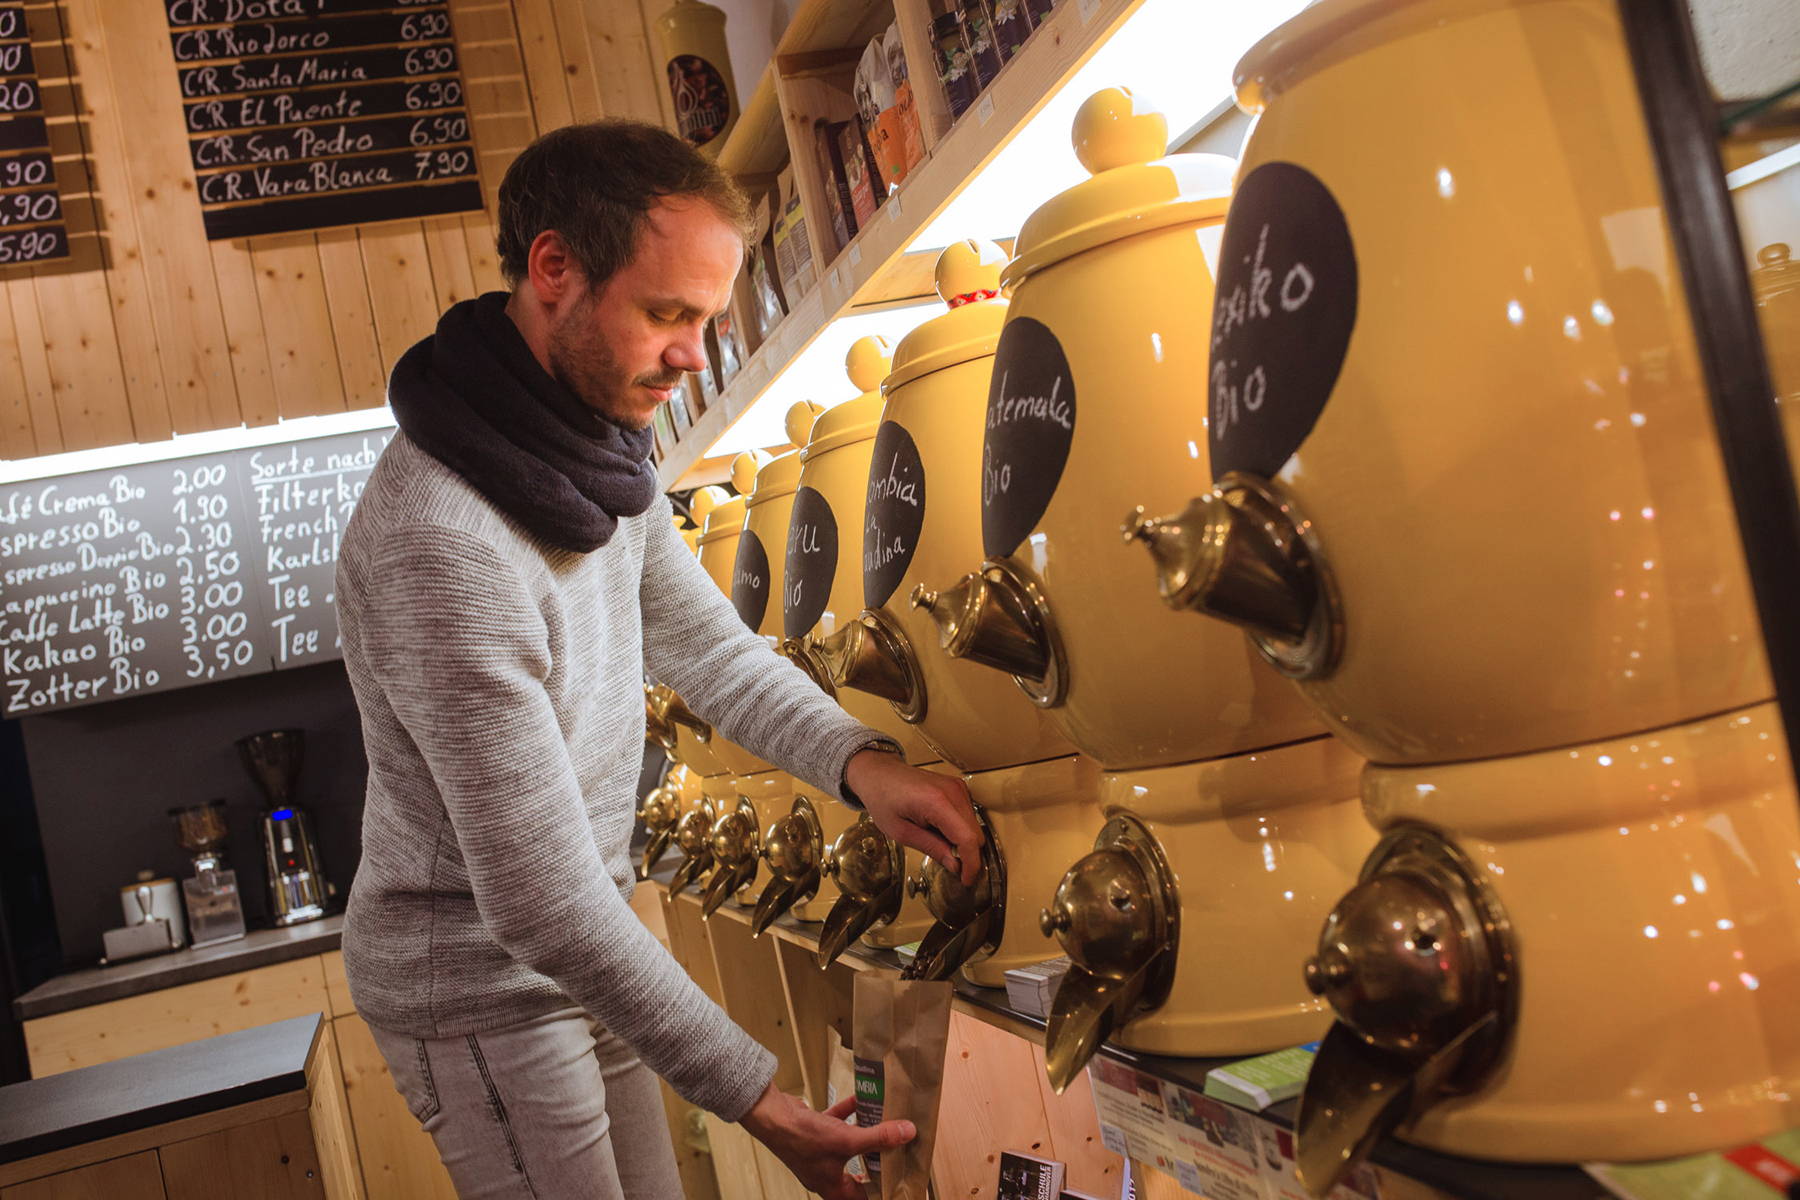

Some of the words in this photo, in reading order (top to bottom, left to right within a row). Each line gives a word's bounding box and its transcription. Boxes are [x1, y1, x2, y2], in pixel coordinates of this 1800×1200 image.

[231, 64, 292, 91] Santa
[297, 57, 367, 85] Maria
[273, 91, 363, 125] Puente
[246, 134, 290, 163] San
[293, 125, 374, 158] Pedro
[254, 167, 310, 196] Vara
[308, 161, 393, 192] Blanca
[987, 370, 1072, 430] atemala
[250, 446, 316, 480] Sorte
[327, 437, 377, 471] nach
[867, 451, 918, 508] ombia
[38, 484, 111, 517] Crema
[109, 474, 146, 503] Bio
[0, 521, 100, 558] spresso
[98, 506, 141, 539] Bio
[258, 503, 338, 544] French
[788, 523, 821, 554] eru
[0, 560, 77, 587] spresso
[136, 531, 175, 561] Bio
[0, 580, 118, 617] appuccino
[119, 565, 167, 595] Bio
[267, 574, 311, 611] Tee
[68, 597, 126, 634] Latte
[126, 593, 170, 625] Bio
[3, 639, 98, 676] Kakao
[104, 624, 146, 659] Bio
[271, 613, 319, 663] Tee
[6, 671, 109, 713] Zotter
[109, 656, 161, 695] Bio
[857, 1080, 878, 1096] MBIA
